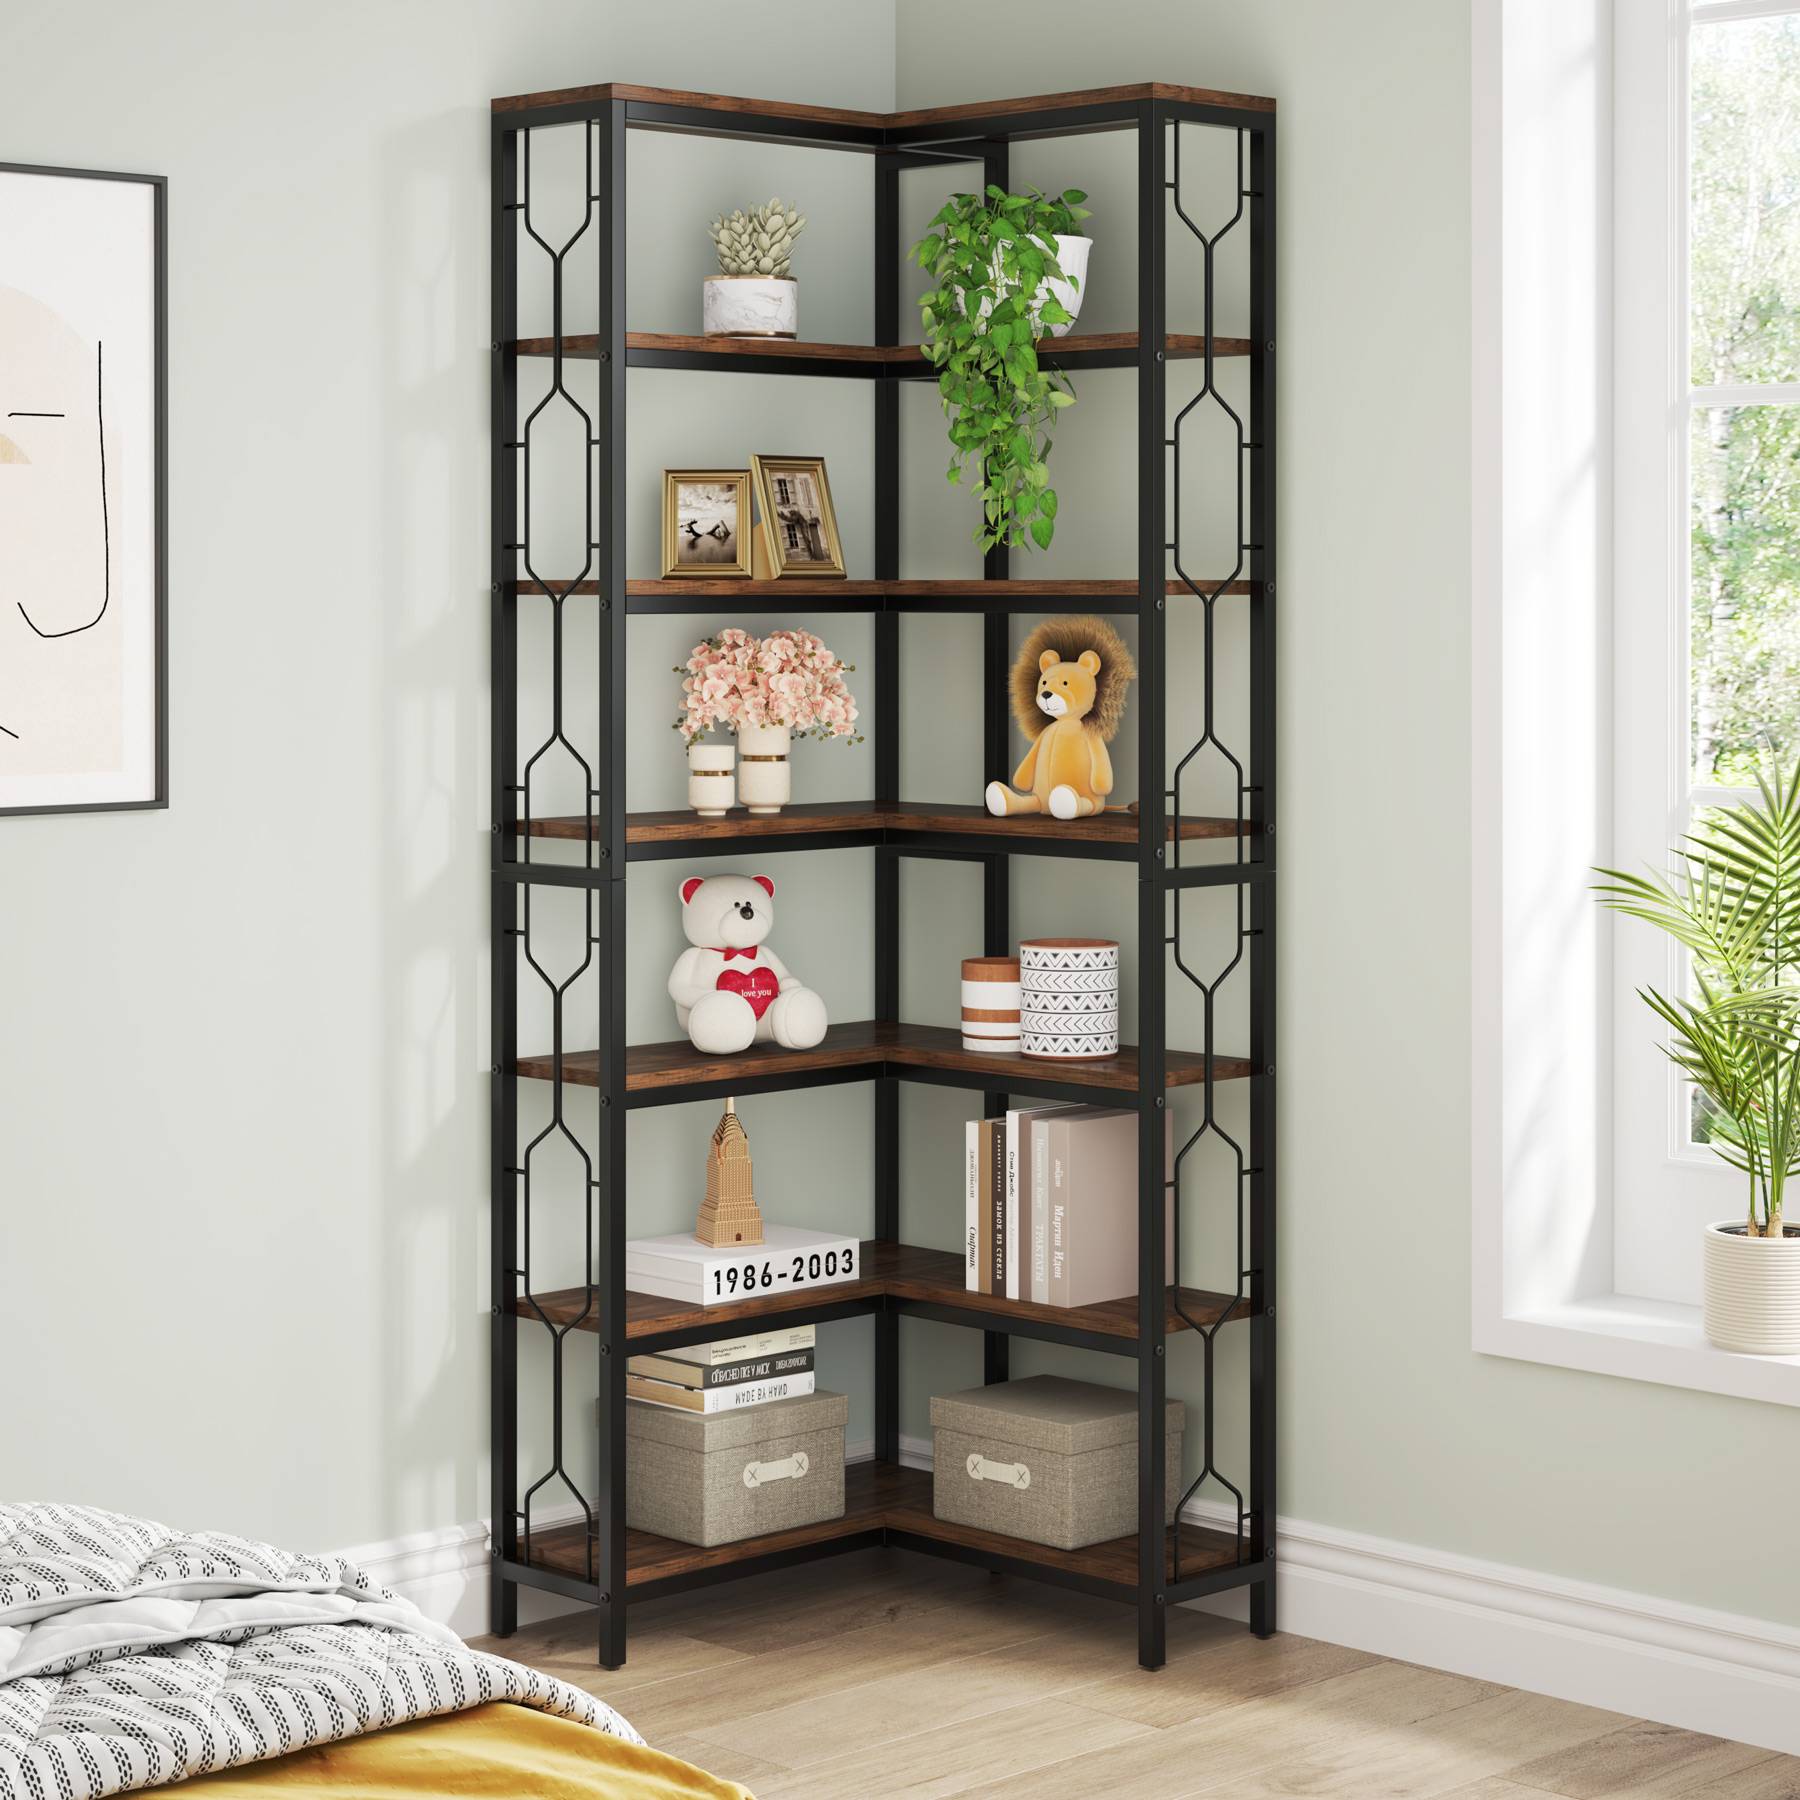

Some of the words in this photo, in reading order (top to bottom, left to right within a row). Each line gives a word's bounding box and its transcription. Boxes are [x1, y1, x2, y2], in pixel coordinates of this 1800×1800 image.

[751, 977, 756, 988] I
[741, 989, 757, 997] love
[757, 989, 772, 999] you
[1053, 1205, 1064, 1247] Мартин
[996, 1233, 1003, 1245] из
[714, 1249, 853, 1295] 1986-2003
